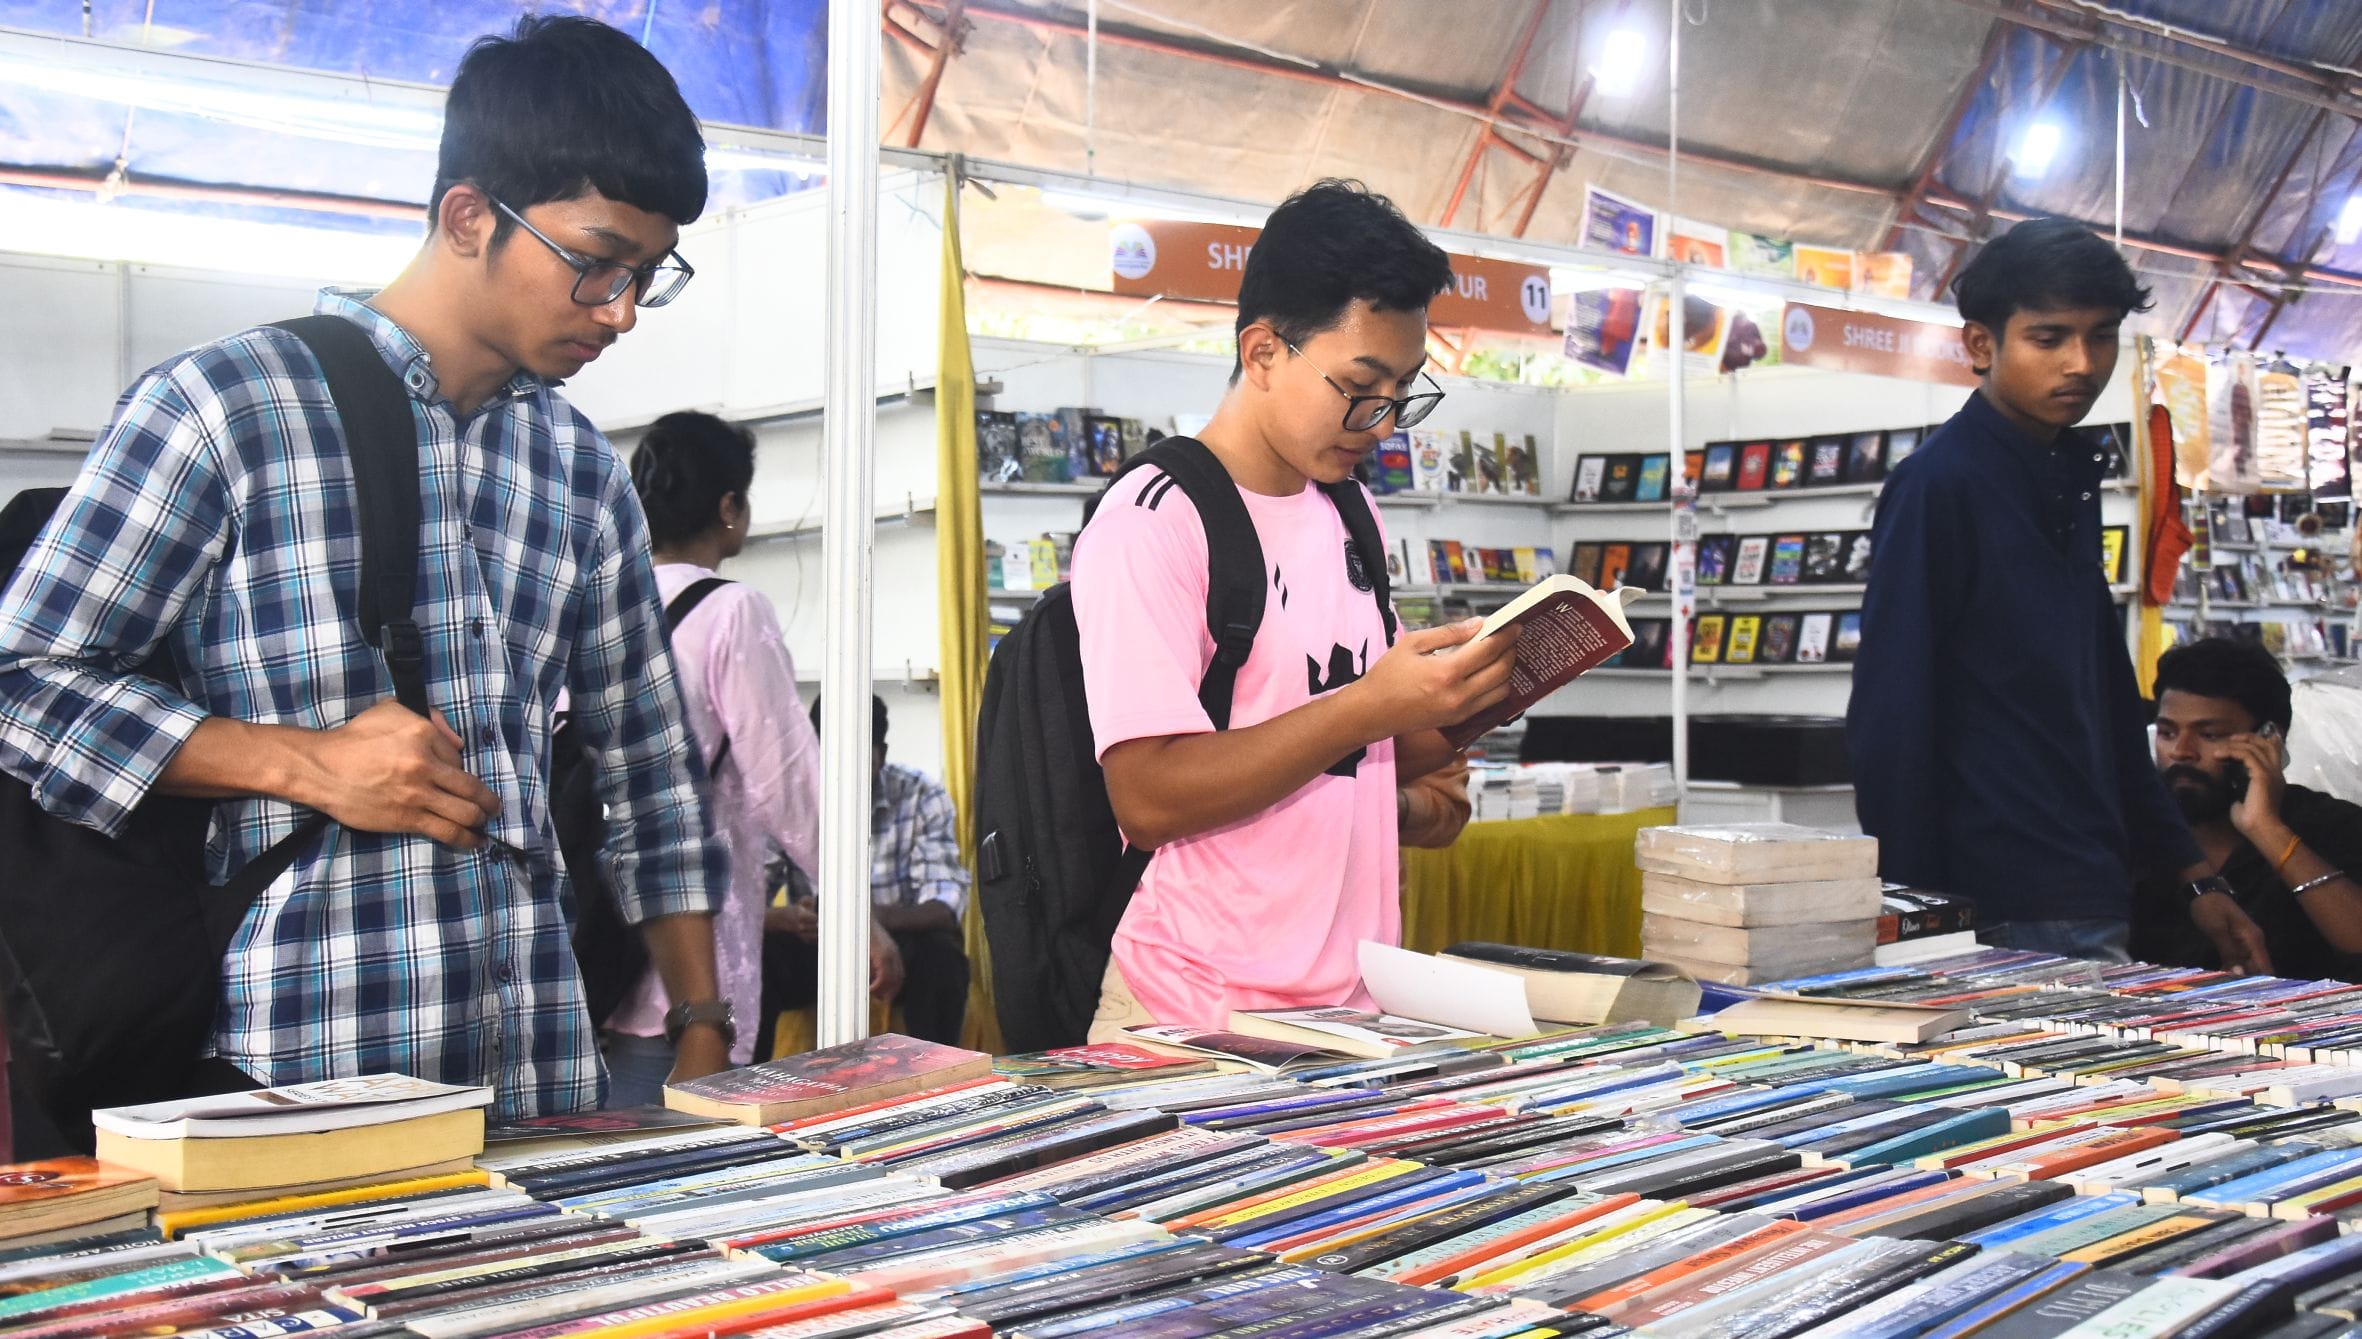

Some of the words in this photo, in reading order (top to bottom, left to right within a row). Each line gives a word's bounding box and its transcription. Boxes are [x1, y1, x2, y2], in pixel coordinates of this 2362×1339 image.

[1207, 242, 1250, 271] SH
[1525, 283, 1547, 310] 11
[1842, 325, 1895, 353] SHREE
[749, 1065, 849, 1092] MAHAGATHA
[1145, 1134, 1187, 1147] ENDS
[1104, 1144, 1152, 1158] WITH
[1429, 1190, 1519, 1229] STOPOVER
[1495, 1206, 1548, 1232] FOUR
[361, 1222, 415, 1234] MARKET
[416, 1215, 460, 1226] STOCK
[877, 1215, 930, 1234] HINDU
[301, 1231, 357, 1244] WIZARD
[791, 1226, 867, 1248] THAROOR
[821, 1230, 877, 1248] SHASHI
[1416, 1226, 1492, 1260] WINDS
[106, 1239, 162, 1255] HOTEL
[119, 1264, 189, 1280] MAAS
[134, 1266, 213, 1285] SARAH
[1254, 1268, 1308, 1284] THIS
[735, 1270, 821, 1299] HELLO
[1202, 1278, 1264, 1297] GIRL
[217, 1306, 288, 1324] SITA
[586, 1287, 733, 1329] BEAUTIFUL
[1230, 1312, 1303, 1336] SALMAN
